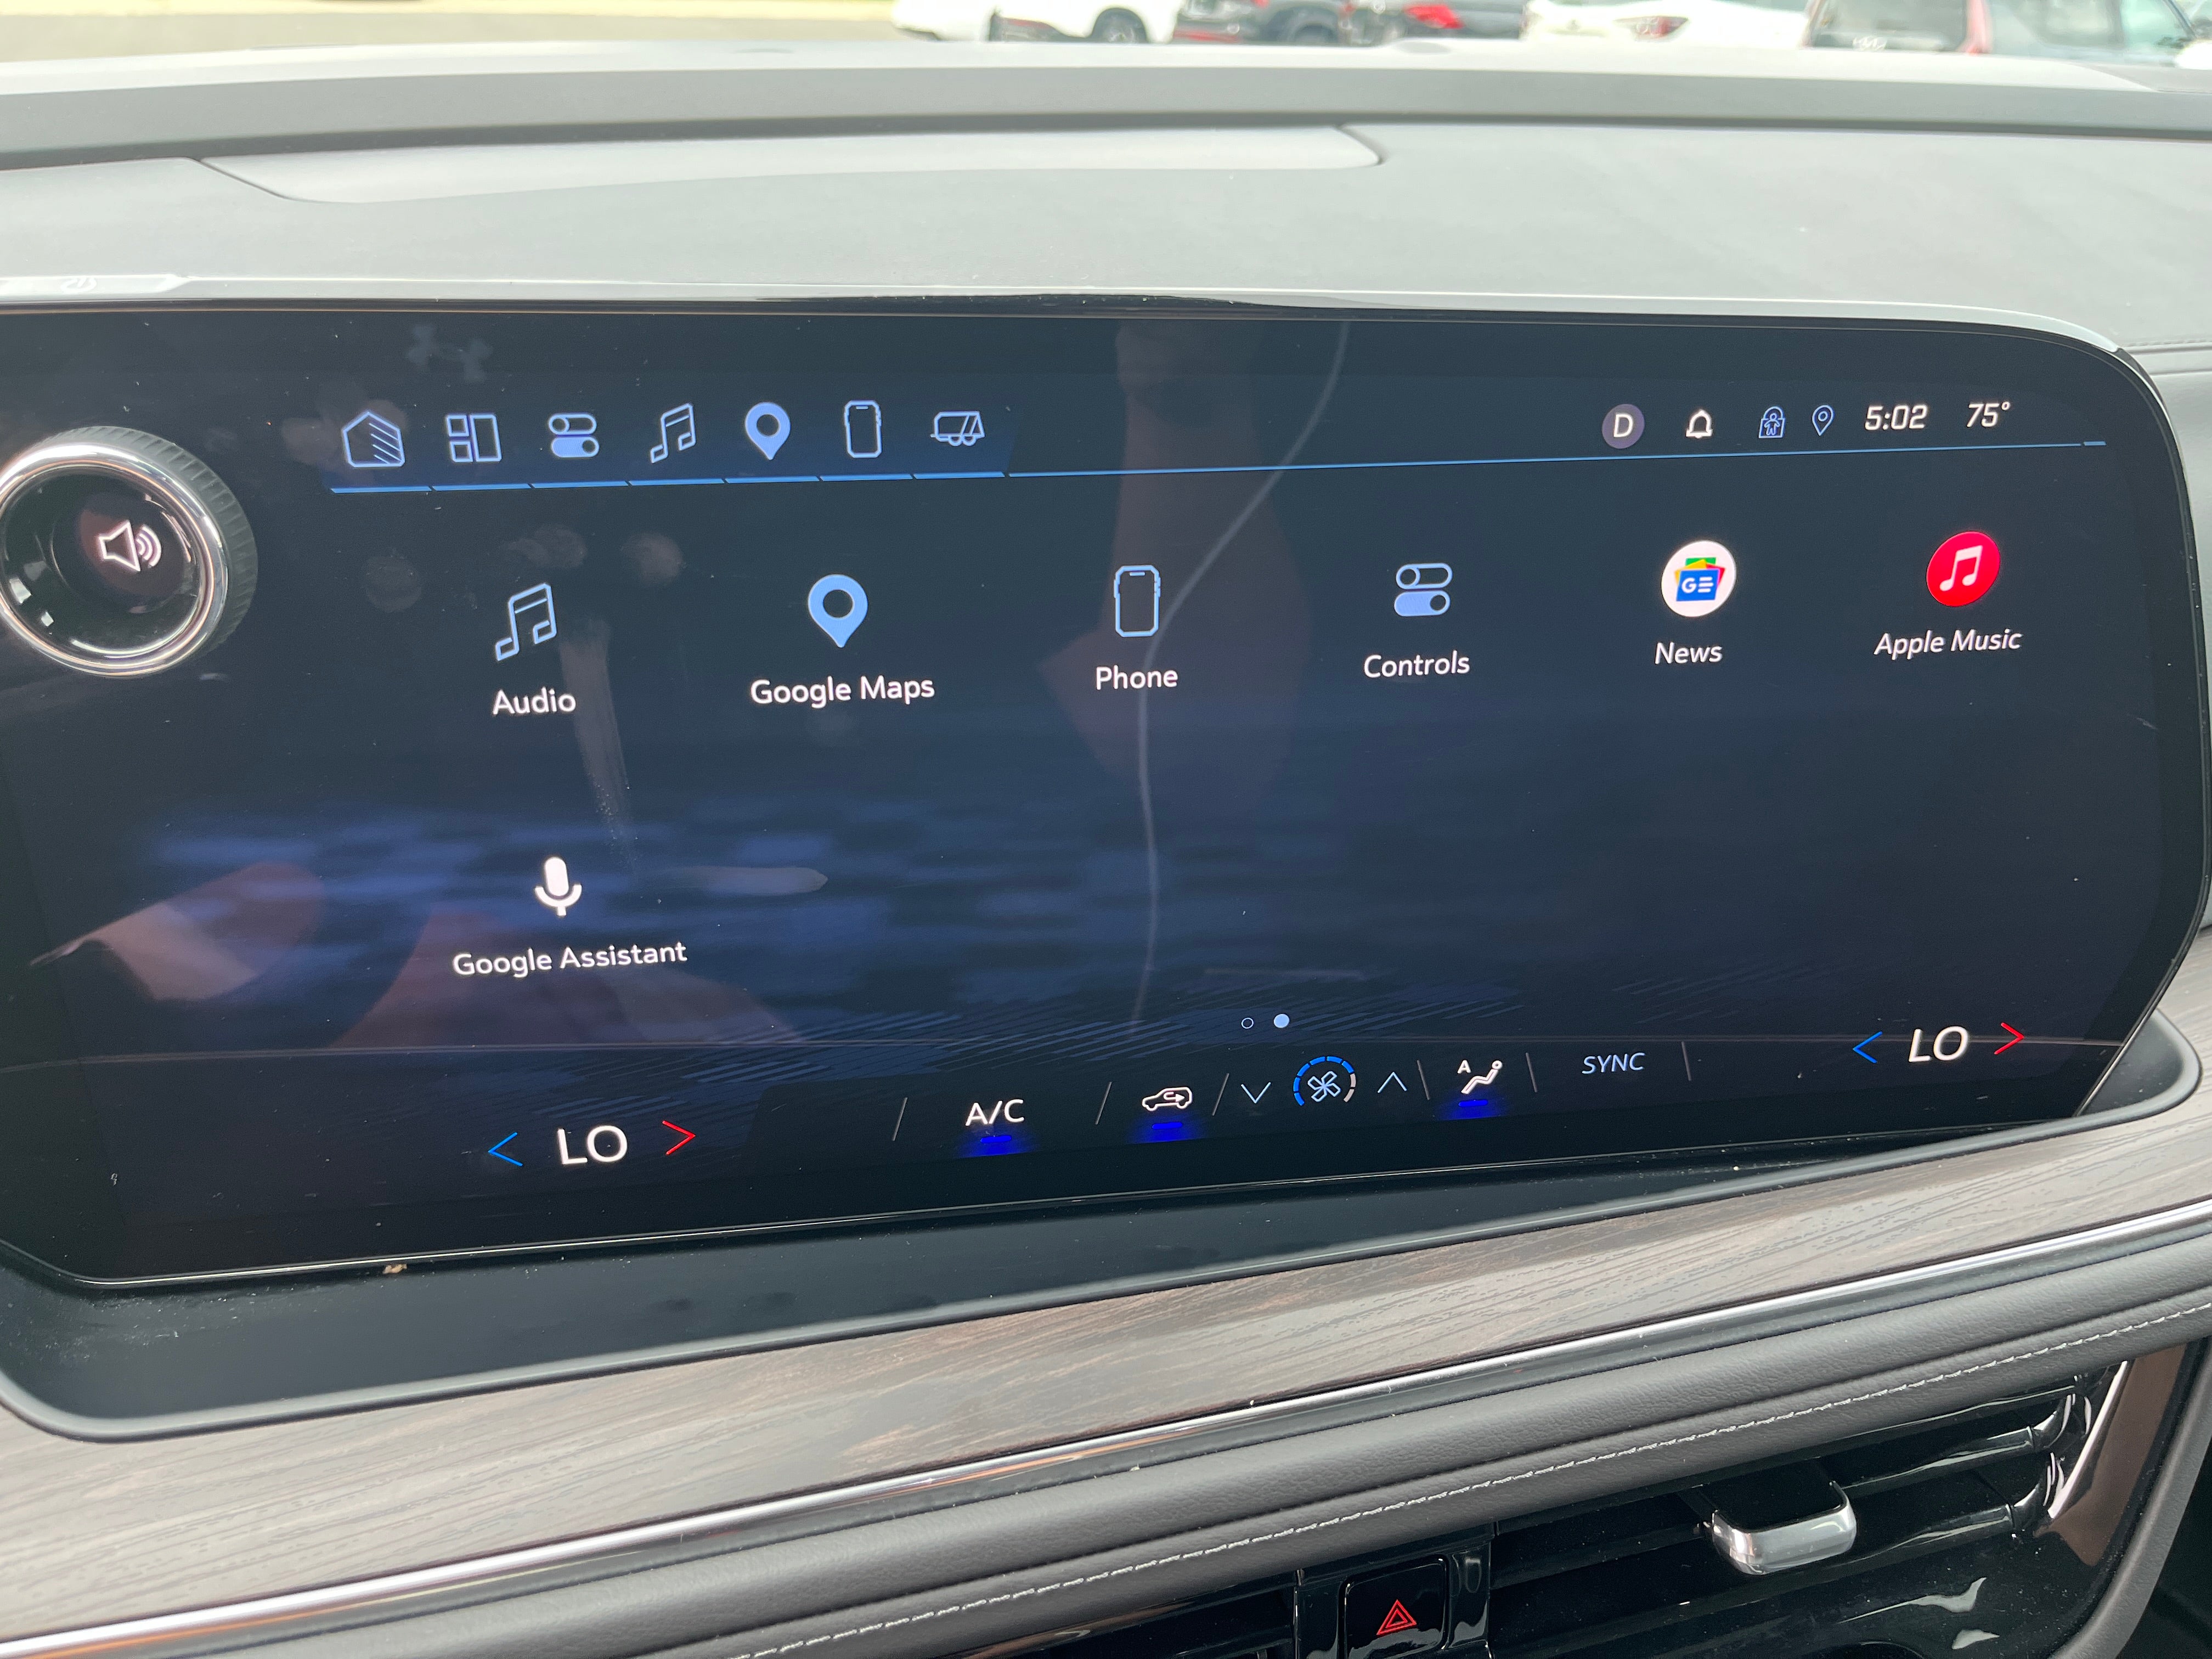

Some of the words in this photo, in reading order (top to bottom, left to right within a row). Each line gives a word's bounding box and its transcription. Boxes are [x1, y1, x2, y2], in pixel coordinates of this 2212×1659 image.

[1613, 413, 1634, 438] D
[1865, 404, 1928, 431] 5:02
[1967, 401, 2011, 427] 75°
[1655, 642, 1722, 664] News
[1874, 630, 1944, 661] Apple
[1950, 628, 2022, 651] Music
[1096, 664, 1178, 690] Phone
[1364, 650, 1470, 678] Controls
[492, 687, 576, 715] Audio
[751, 675, 851, 709] Google
[860, 675, 935, 705] Maps
[452, 948, 552, 978] Google
[560, 942, 688, 969] Assistant
[1908, 1026, 1969, 1062] LO
[1457, 1060, 1471, 1074] A
[1582, 1052, 1645, 1074] SYNC
[965, 1099, 1024, 1126] A/C
[557, 1125, 628, 1165] LO
